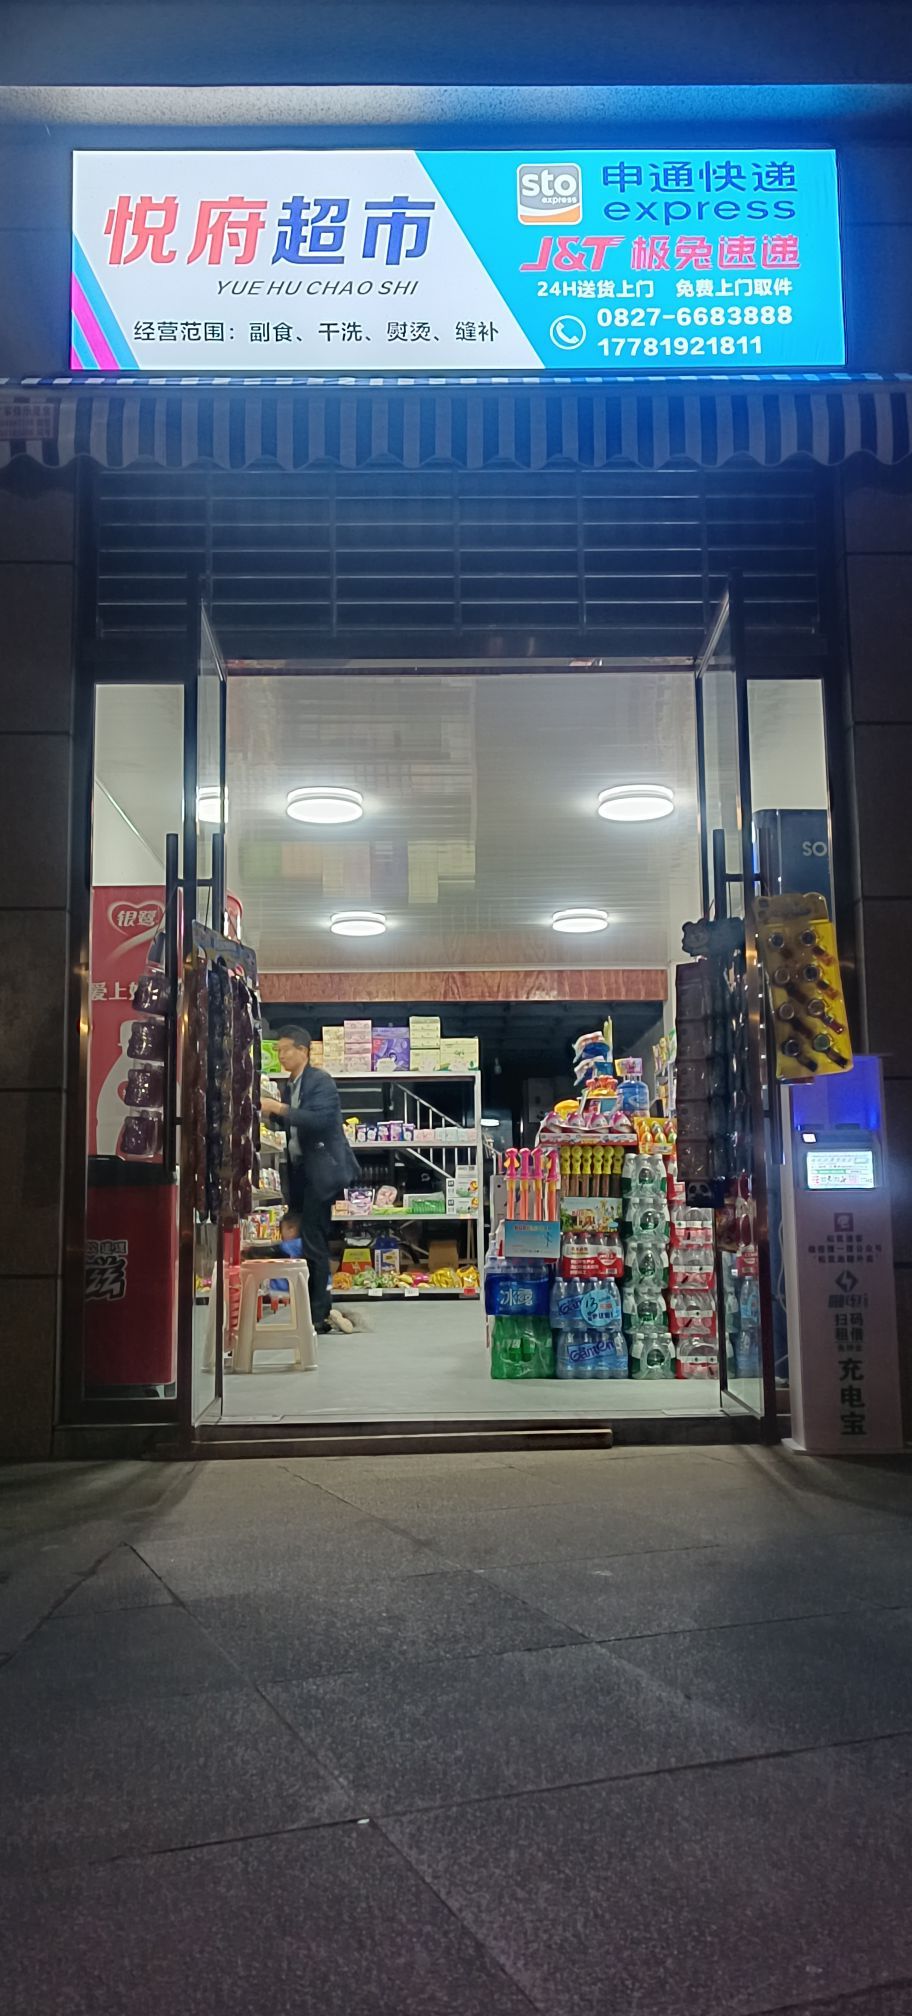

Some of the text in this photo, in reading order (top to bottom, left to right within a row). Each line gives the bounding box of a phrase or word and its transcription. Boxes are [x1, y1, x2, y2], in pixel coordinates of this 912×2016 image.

[522, 169, 577, 197] sto
[602, 161, 798, 193] 申通快递
[541, 197, 577, 205] express
[603, 200, 796, 226] express
[104, 194, 436, 266] 悦府超市
[519, 234, 800, 272] J&T 极兔速递
[215, 280, 419, 295] YUE HU CHAO SHI
[537, 277, 793, 298] 24H送货上门 免费上门取件
[597, 305, 793, 327] 0827-6683888
[597, 336, 763, 356] 17781921811
[802, 841, 828, 857] SO
[835, 1312, 863, 1326] 扫码
[838, 1357, 867, 1436] 充电宝
